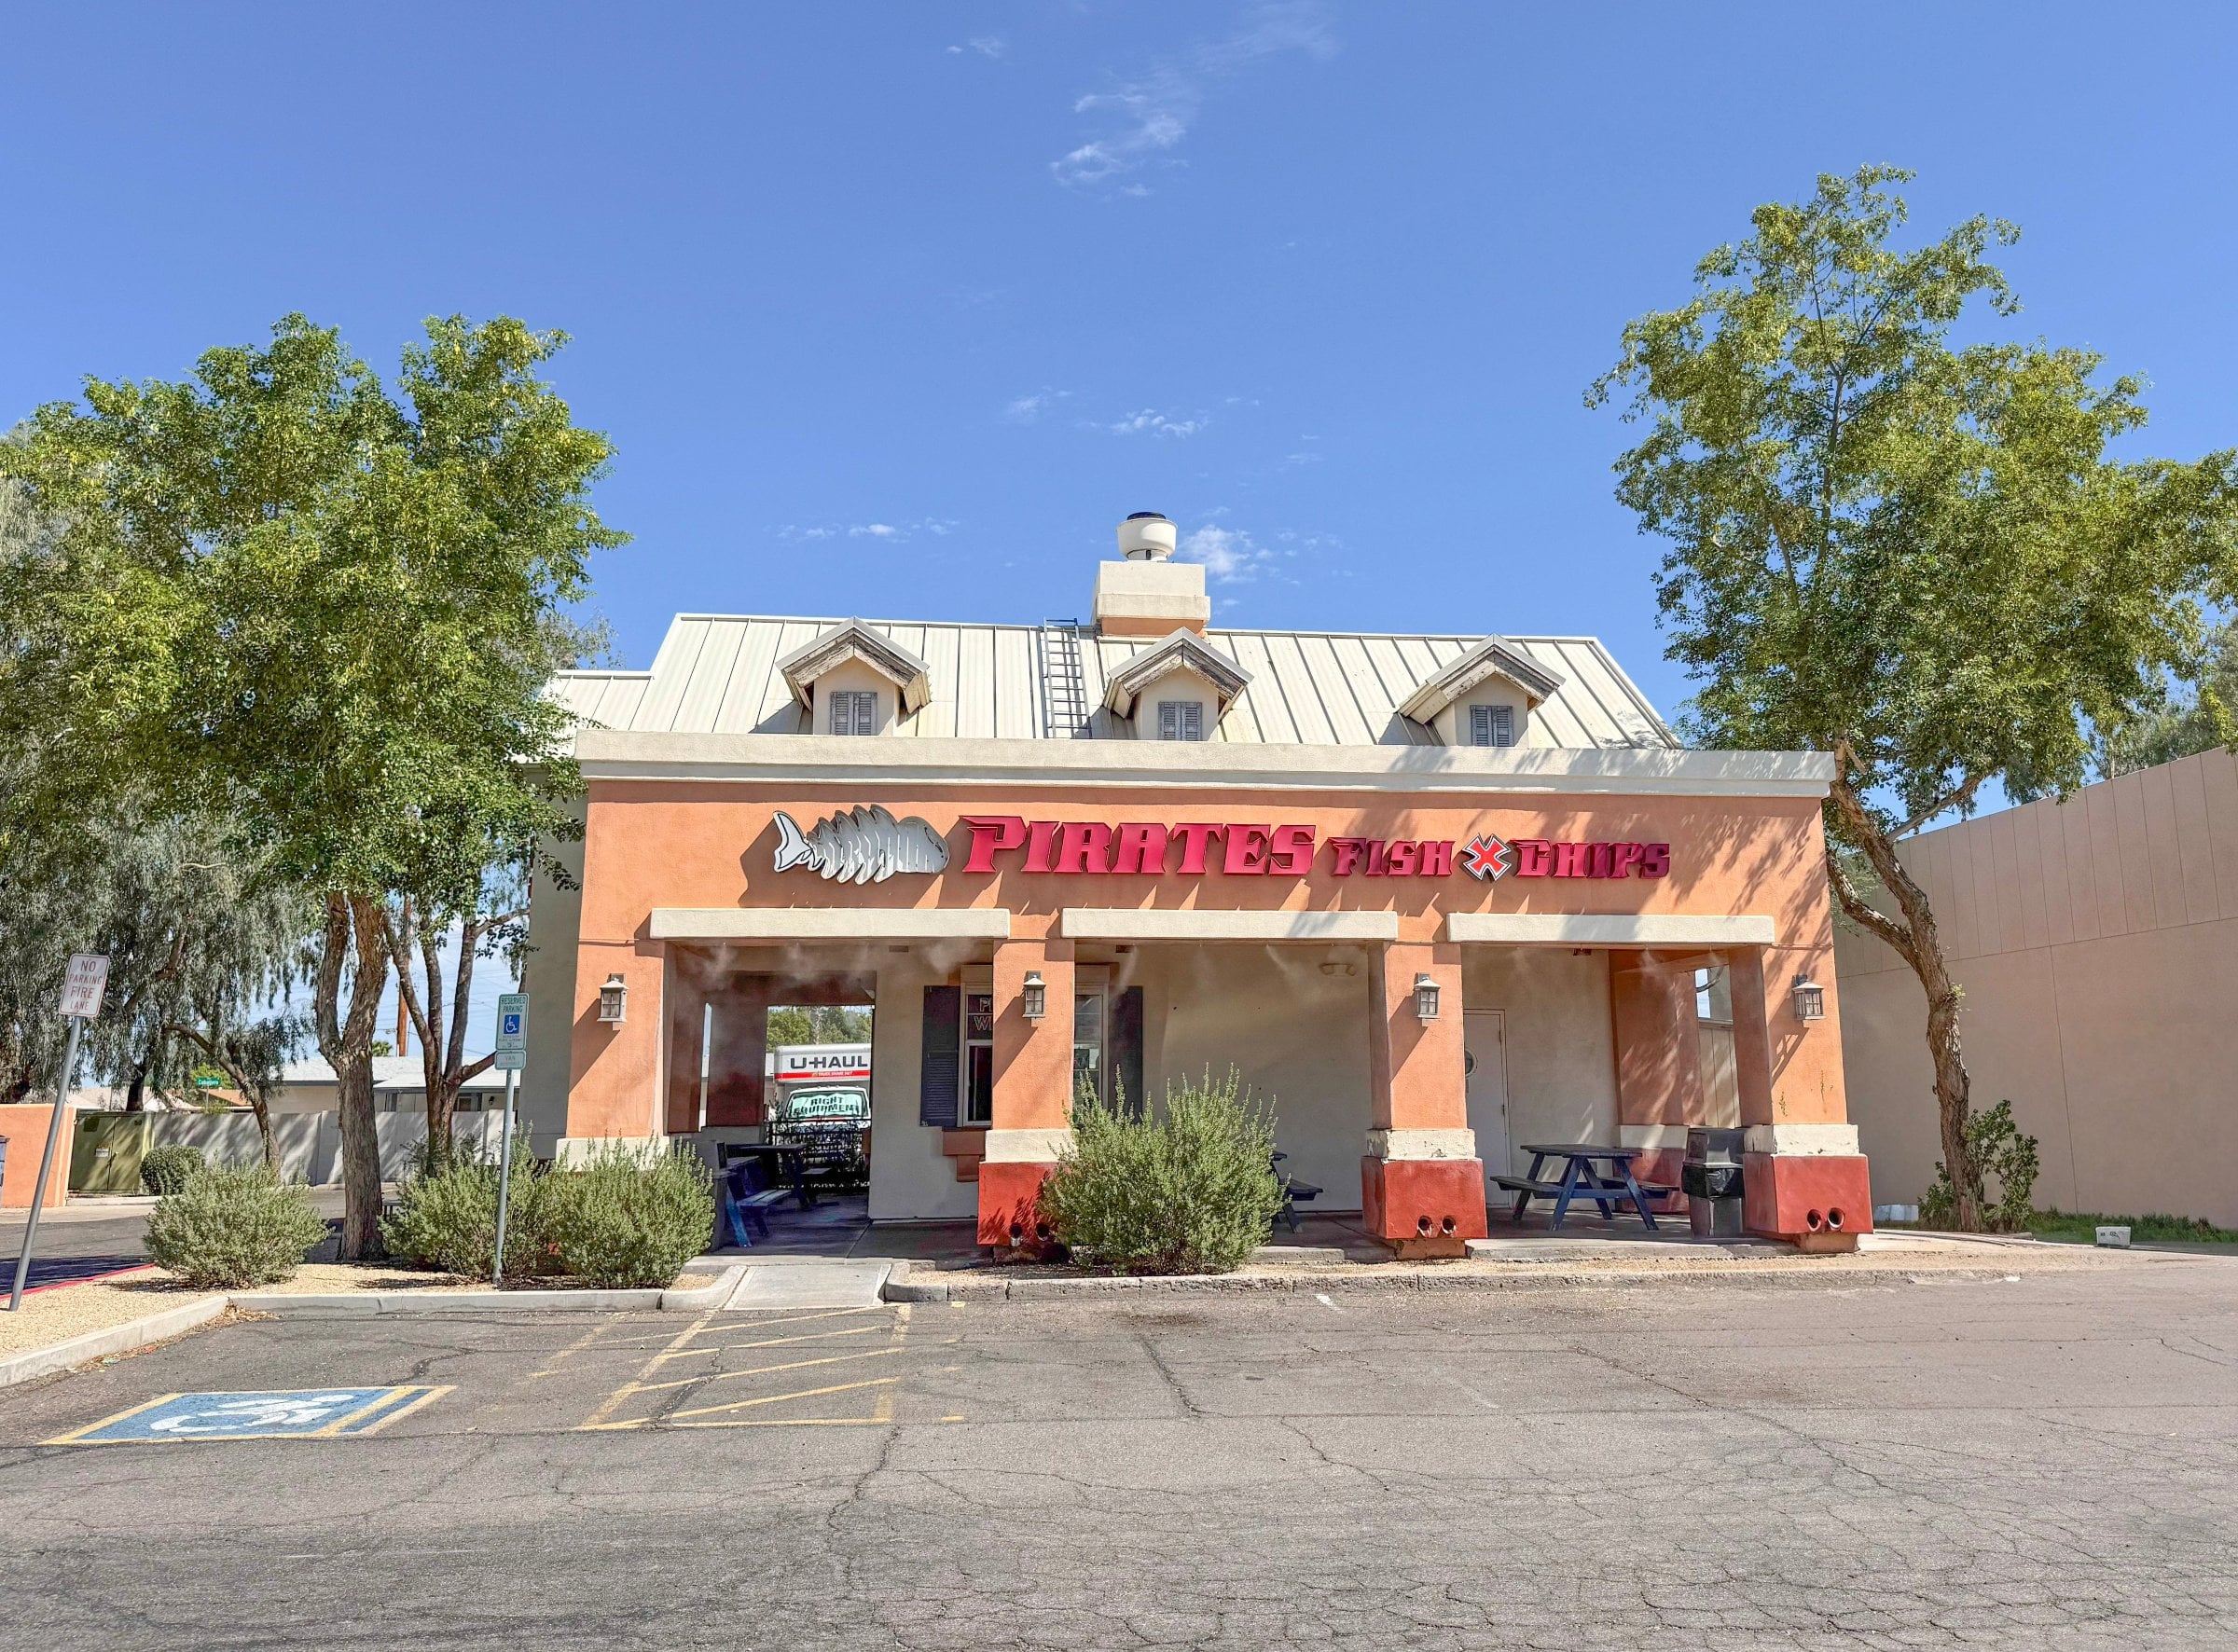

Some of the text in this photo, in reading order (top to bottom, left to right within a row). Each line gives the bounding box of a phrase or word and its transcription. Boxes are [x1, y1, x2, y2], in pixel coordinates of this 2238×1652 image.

[959, 816, 1316, 874] PIRATES
[1328, 837, 1455, 876] FISH
[1508, 839, 1670, 879] CHIPS
[80, 960, 96, 971] NO
[69, 973, 103, 985] PARKING
[70, 986, 95, 998] FIRE
[70, 1000, 90, 1011] LANE
[501, 997, 526, 1005] RESERVED
[503, 1005, 523, 1013] PARKING
[791, 1055, 868, 1069] U-HAUL
[810, 1096, 844, 1106] RIGHT
